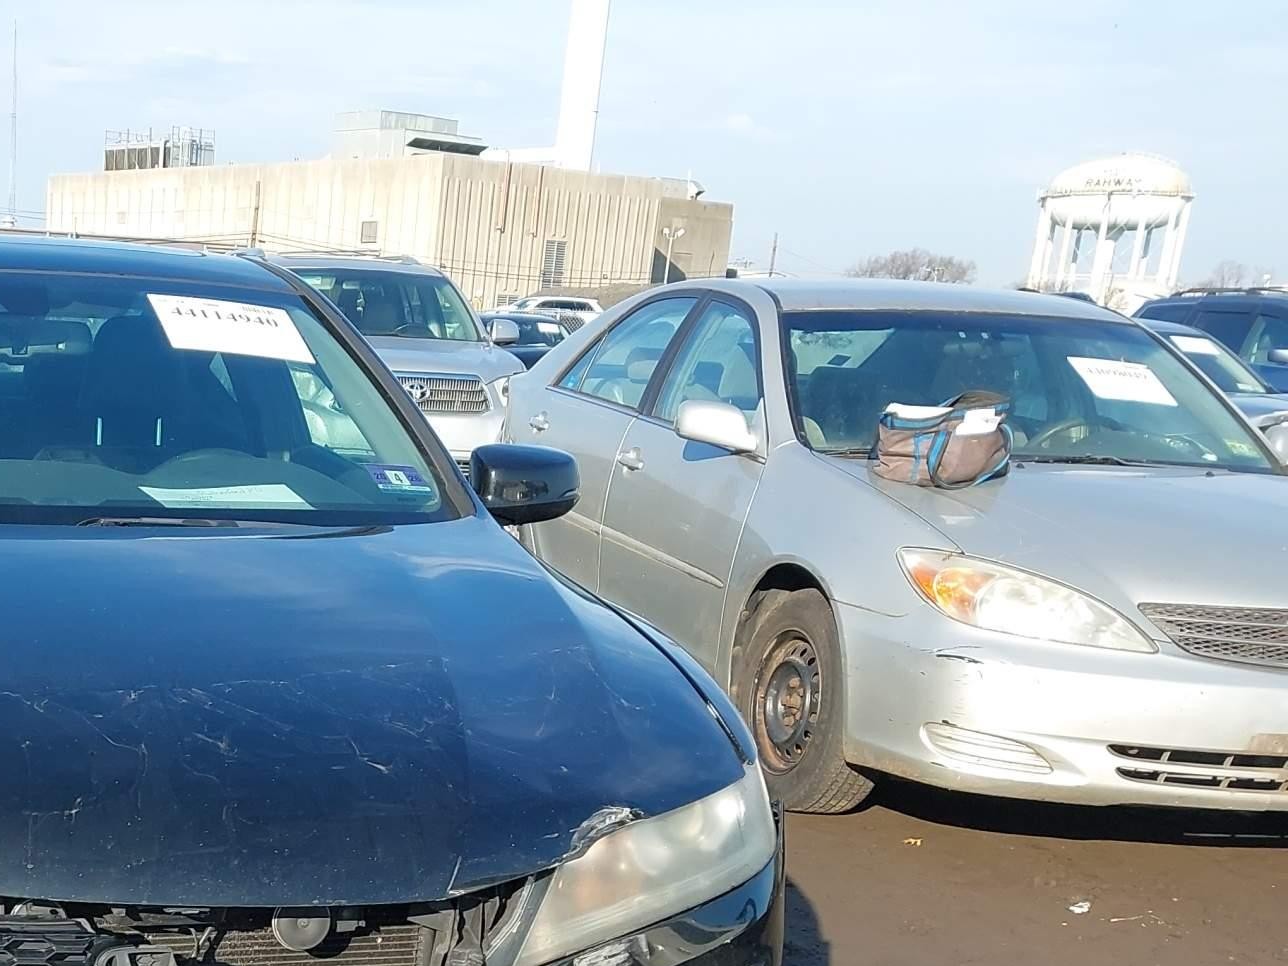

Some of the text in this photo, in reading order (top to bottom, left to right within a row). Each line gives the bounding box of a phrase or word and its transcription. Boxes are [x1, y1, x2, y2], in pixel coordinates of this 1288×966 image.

[1084, 177, 1143, 188] RAHWAY
[170, 306, 280, 328] 44114940
[393, 473, 404, 484] 4
